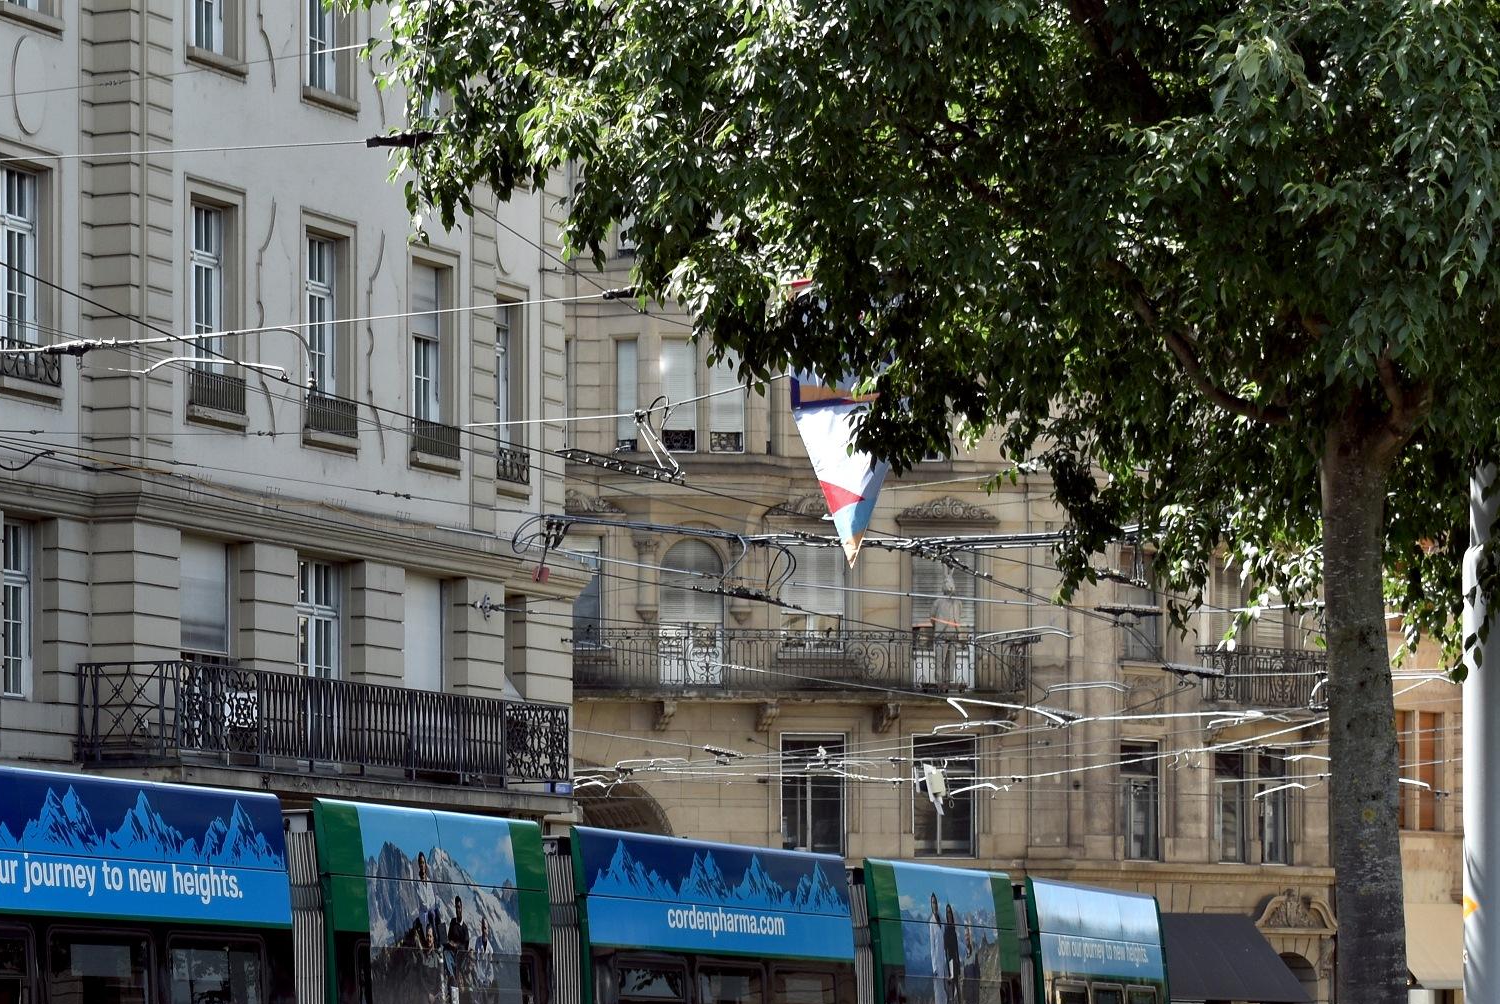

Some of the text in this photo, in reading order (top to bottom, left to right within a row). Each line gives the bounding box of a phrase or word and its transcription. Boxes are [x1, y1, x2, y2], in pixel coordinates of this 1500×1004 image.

[23, 852, 97, 897] journey
[102, 860, 124, 891] to
[128, 867, 167, 894] new
[171, 863, 244, 905] heights.
[667, 904, 786, 938] cordenpharma.com
[1057, 936, 1072, 957] Join
[1082, 939, 1105, 965] journey
